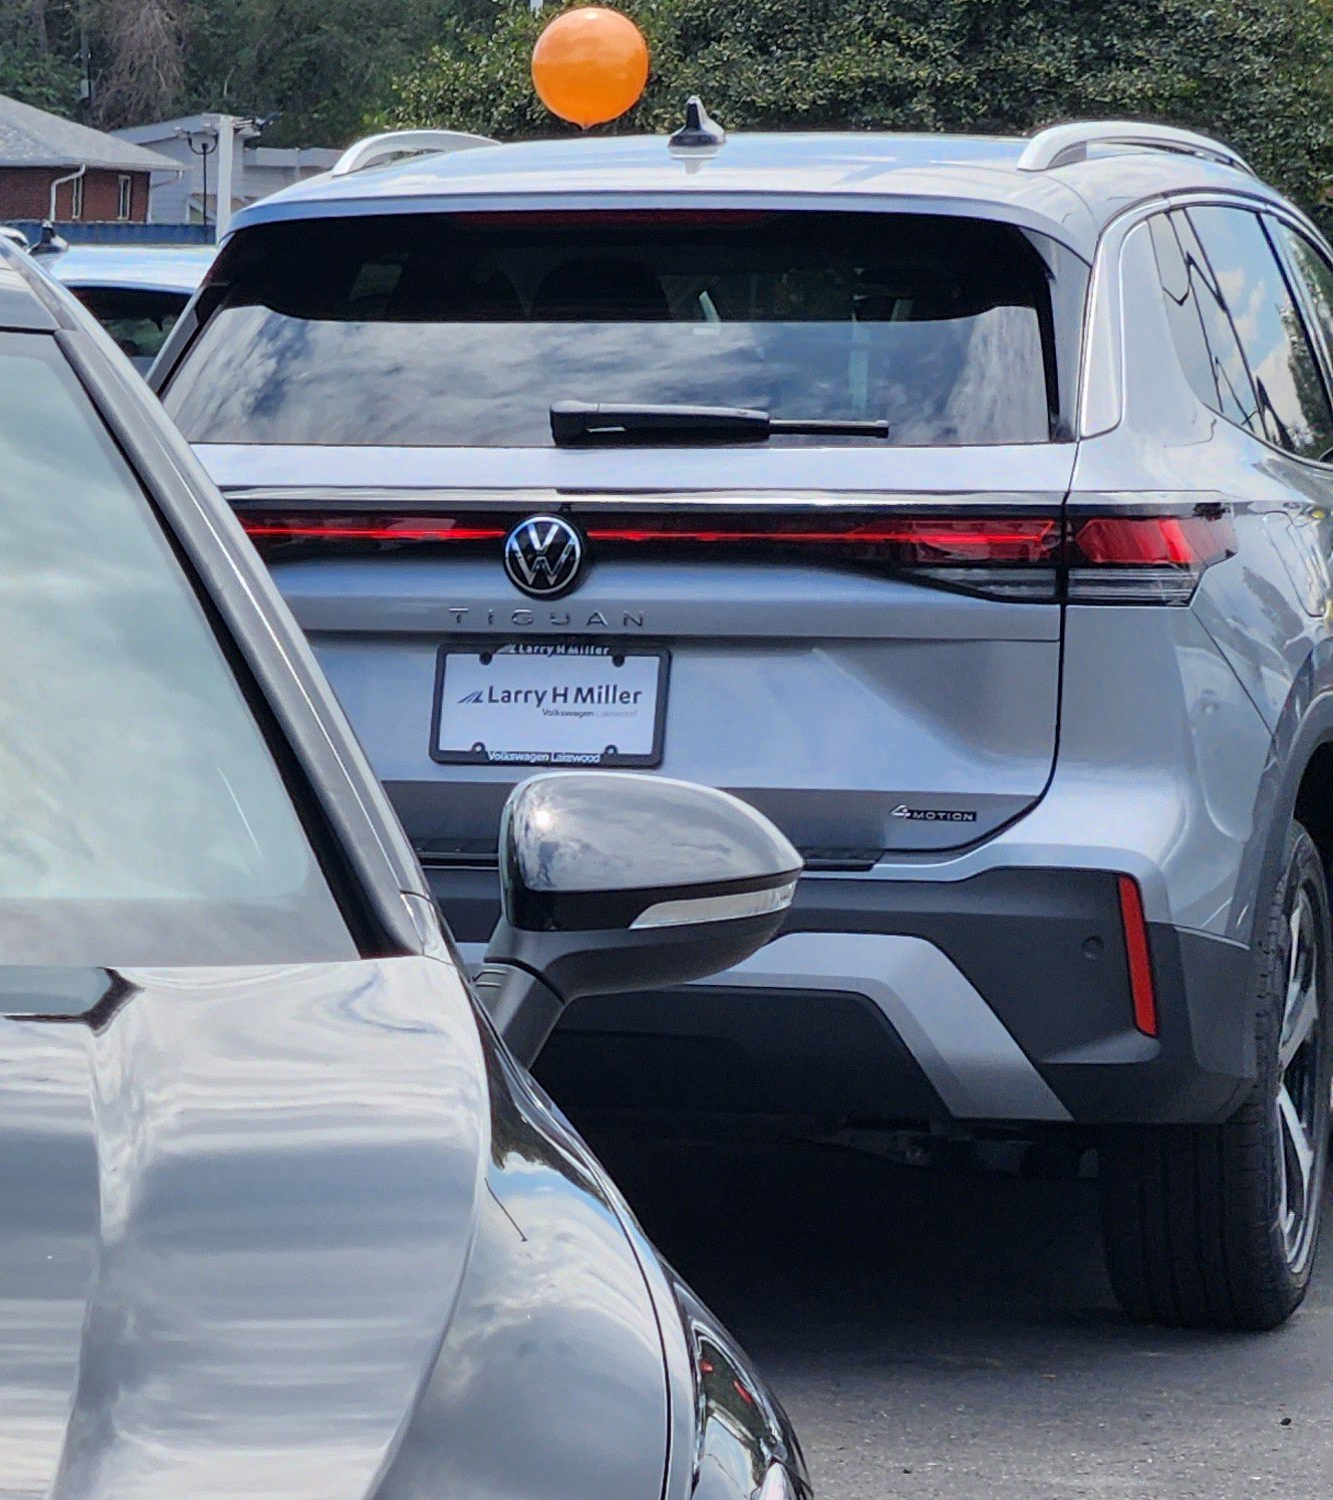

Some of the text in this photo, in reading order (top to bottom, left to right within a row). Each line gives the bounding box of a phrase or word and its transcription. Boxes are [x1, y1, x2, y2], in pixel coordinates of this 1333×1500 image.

[449, 607, 646, 628] TIGUAN
[519, 644, 610, 657] Larry H Miller
[487, 683, 643, 708] Larry H Miller
[542, 708, 594, 719] Volkswagen
[488, 751, 601, 764] Volkswagen Lakewood
